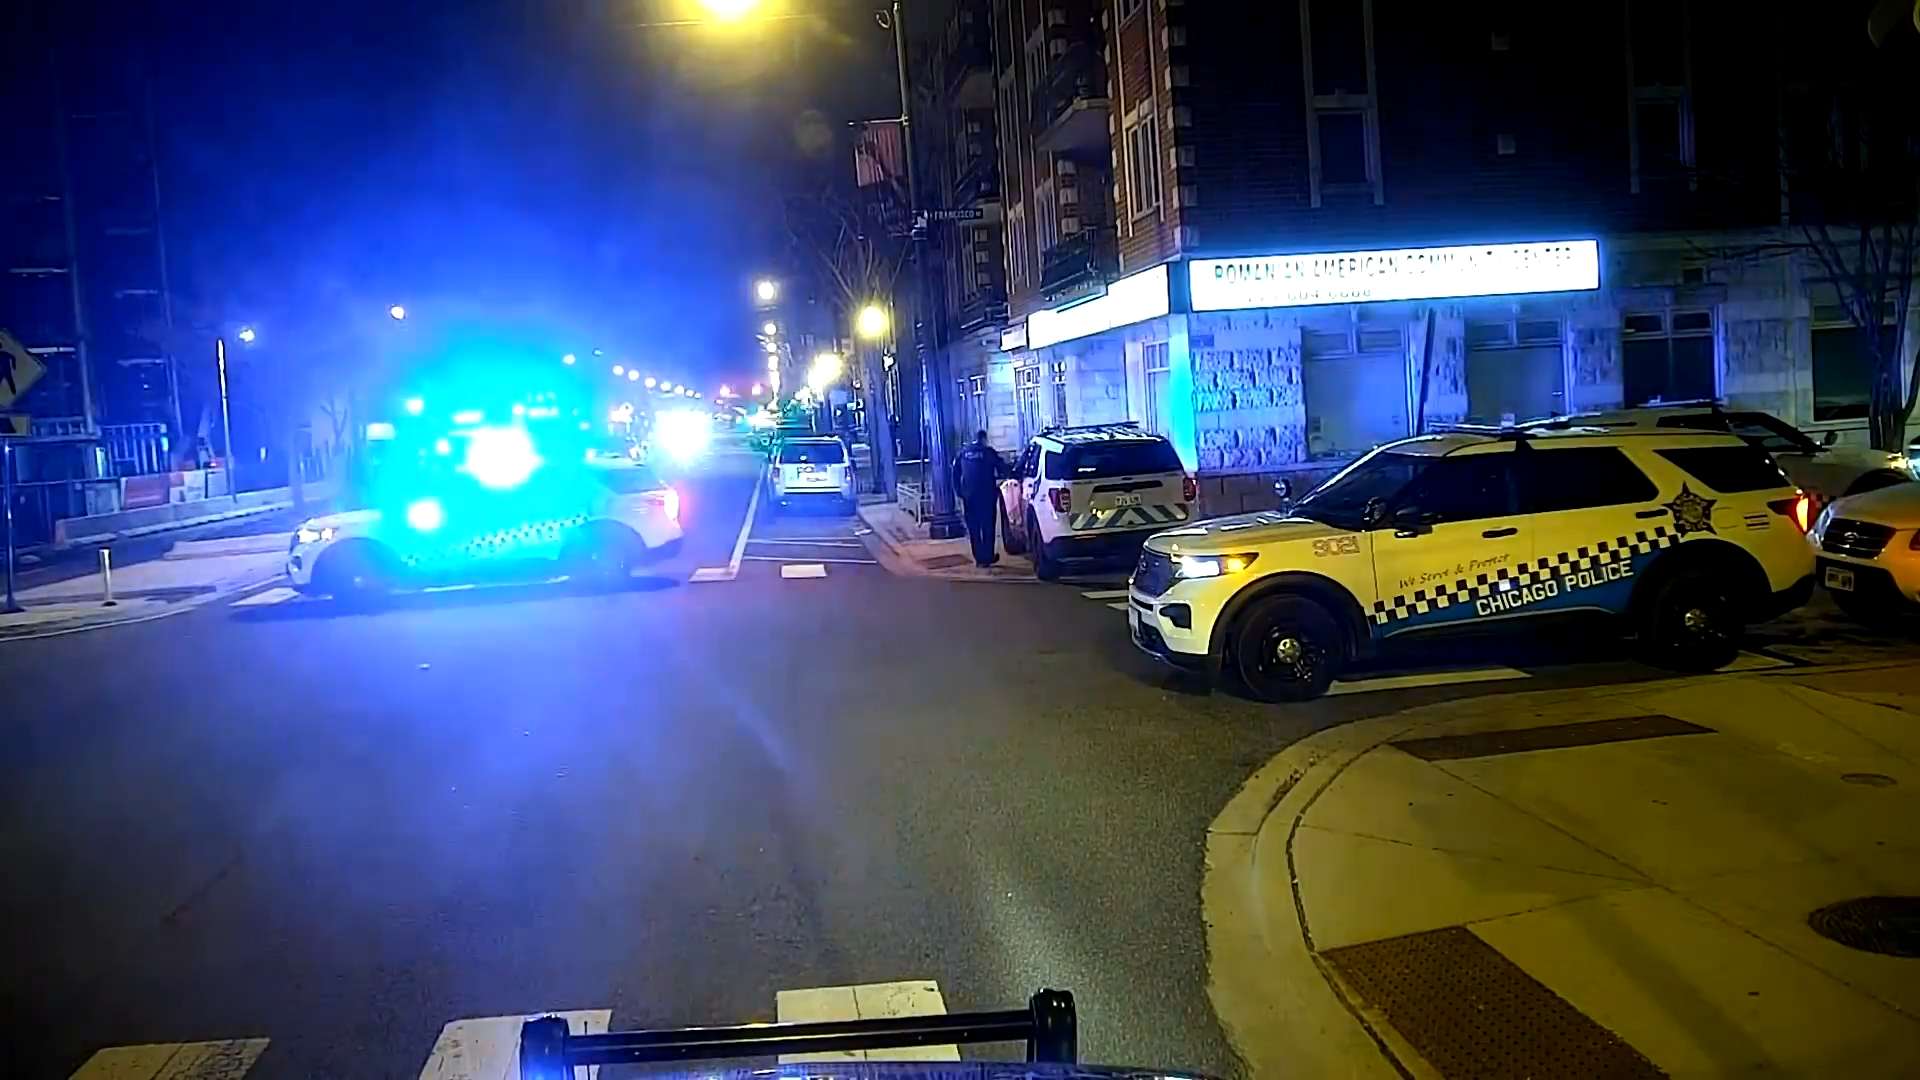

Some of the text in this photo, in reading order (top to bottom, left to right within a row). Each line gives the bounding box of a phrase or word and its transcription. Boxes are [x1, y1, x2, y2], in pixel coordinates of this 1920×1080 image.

[934, 209, 975, 220] FRANCISCO
[1214, 259, 1305, 283] ROMANAN
[1313, 255, 1399, 278] AMERICAN
[1407, 250, 1506, 275] COMMNT
[1420, 569, 1449, 584] Serve
[1476, 560, 1634, 616] CHICAGO POLICE
